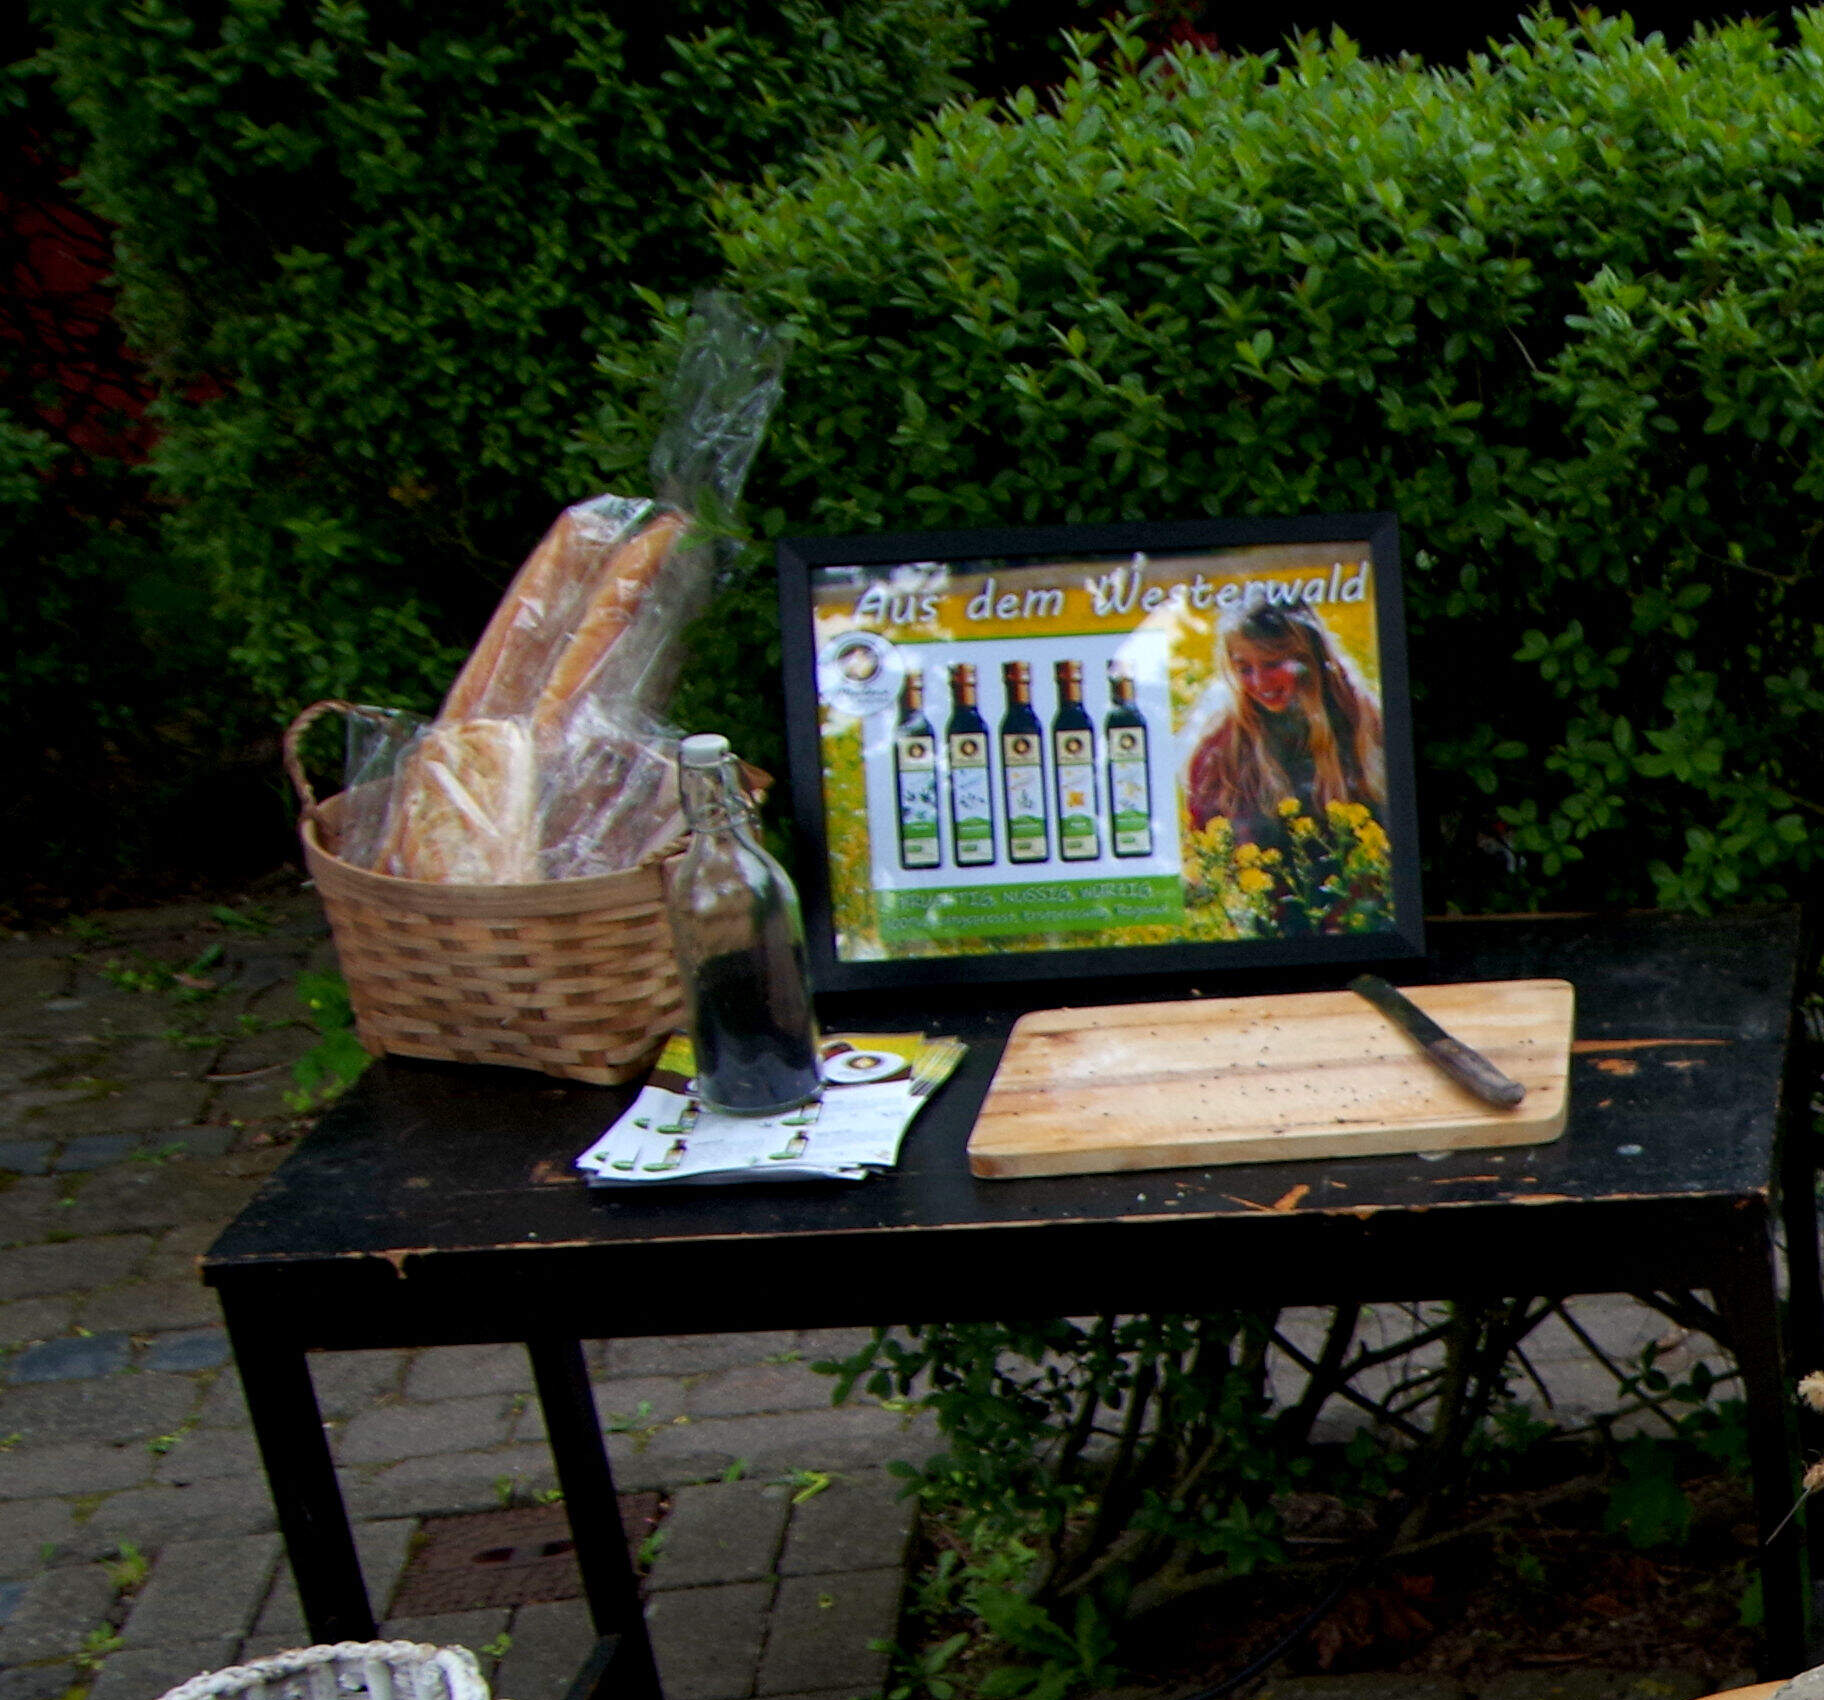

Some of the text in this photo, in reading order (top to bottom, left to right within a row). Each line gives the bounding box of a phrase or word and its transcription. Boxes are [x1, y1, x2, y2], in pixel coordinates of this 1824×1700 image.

[854, 557, 1370, 626] Aus dem Westerwald
